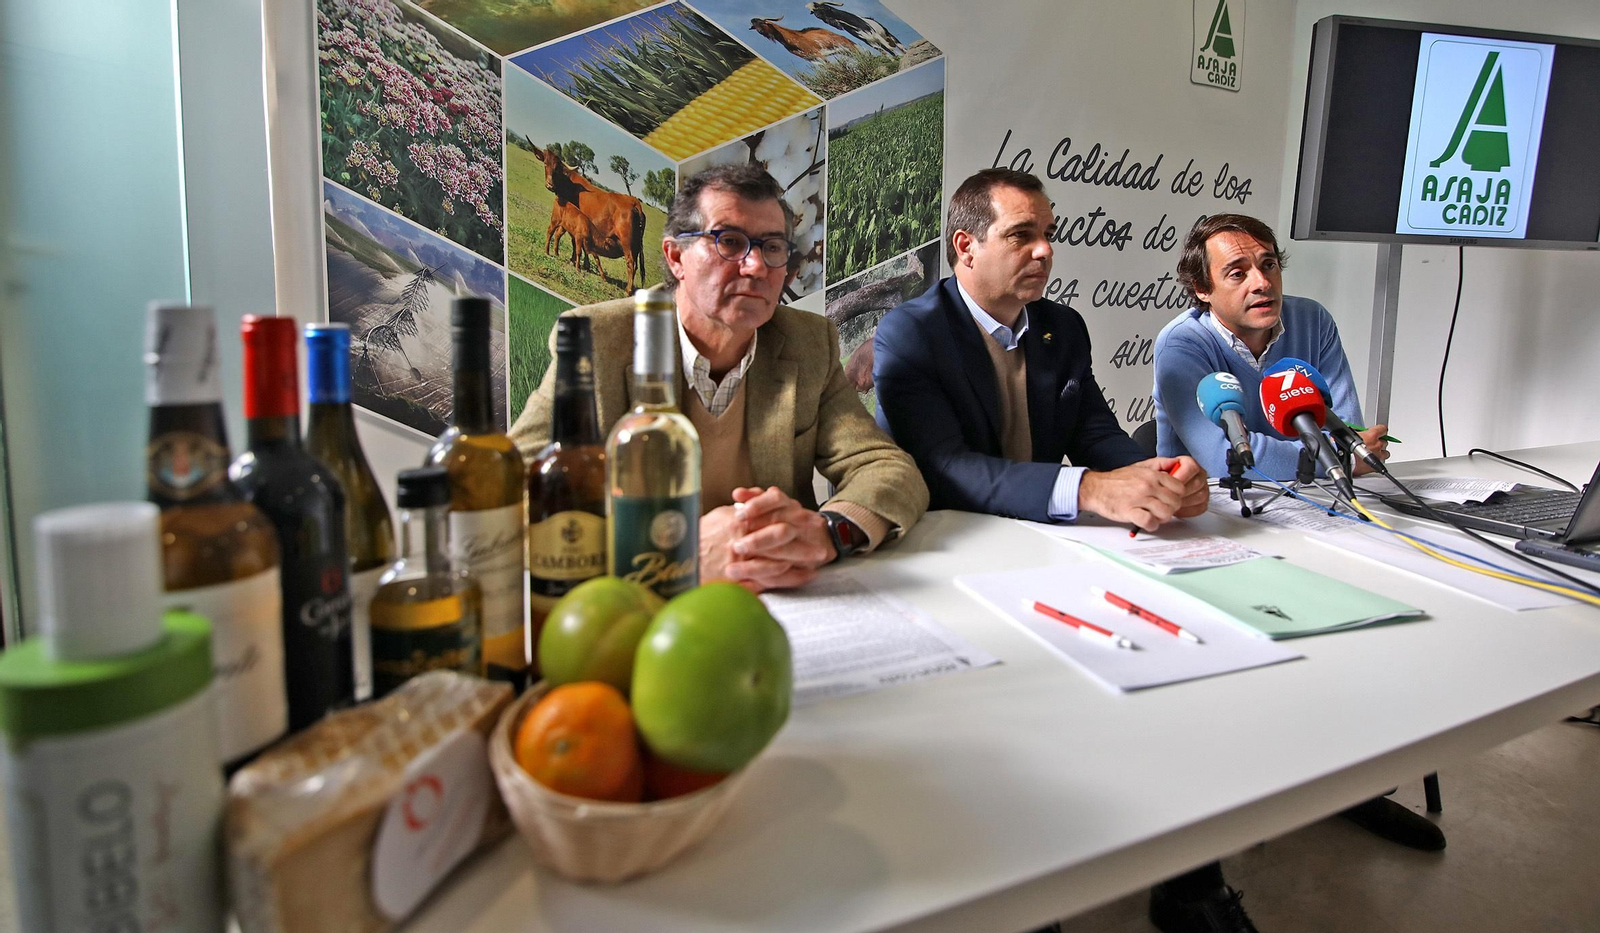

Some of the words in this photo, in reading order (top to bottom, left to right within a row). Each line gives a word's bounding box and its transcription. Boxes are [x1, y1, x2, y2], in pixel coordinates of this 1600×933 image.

[1198, 55, 1237, 77] ASAJA
[1208, 72, 1236, 88] CADIZ
[992, 129, 1034, 174] La
[1047, 137, 1164, 191] Calidad
[1171, 159, 1204, 197] de
[1213, 163, 1252, 204] los
[1421, 174, 1511, 206] ASAJA
[1442, 203, 1508, 227] CADIZ
[1143, 214, 1178, 252] de
[1092, 272, 1195, 311] cuestio
